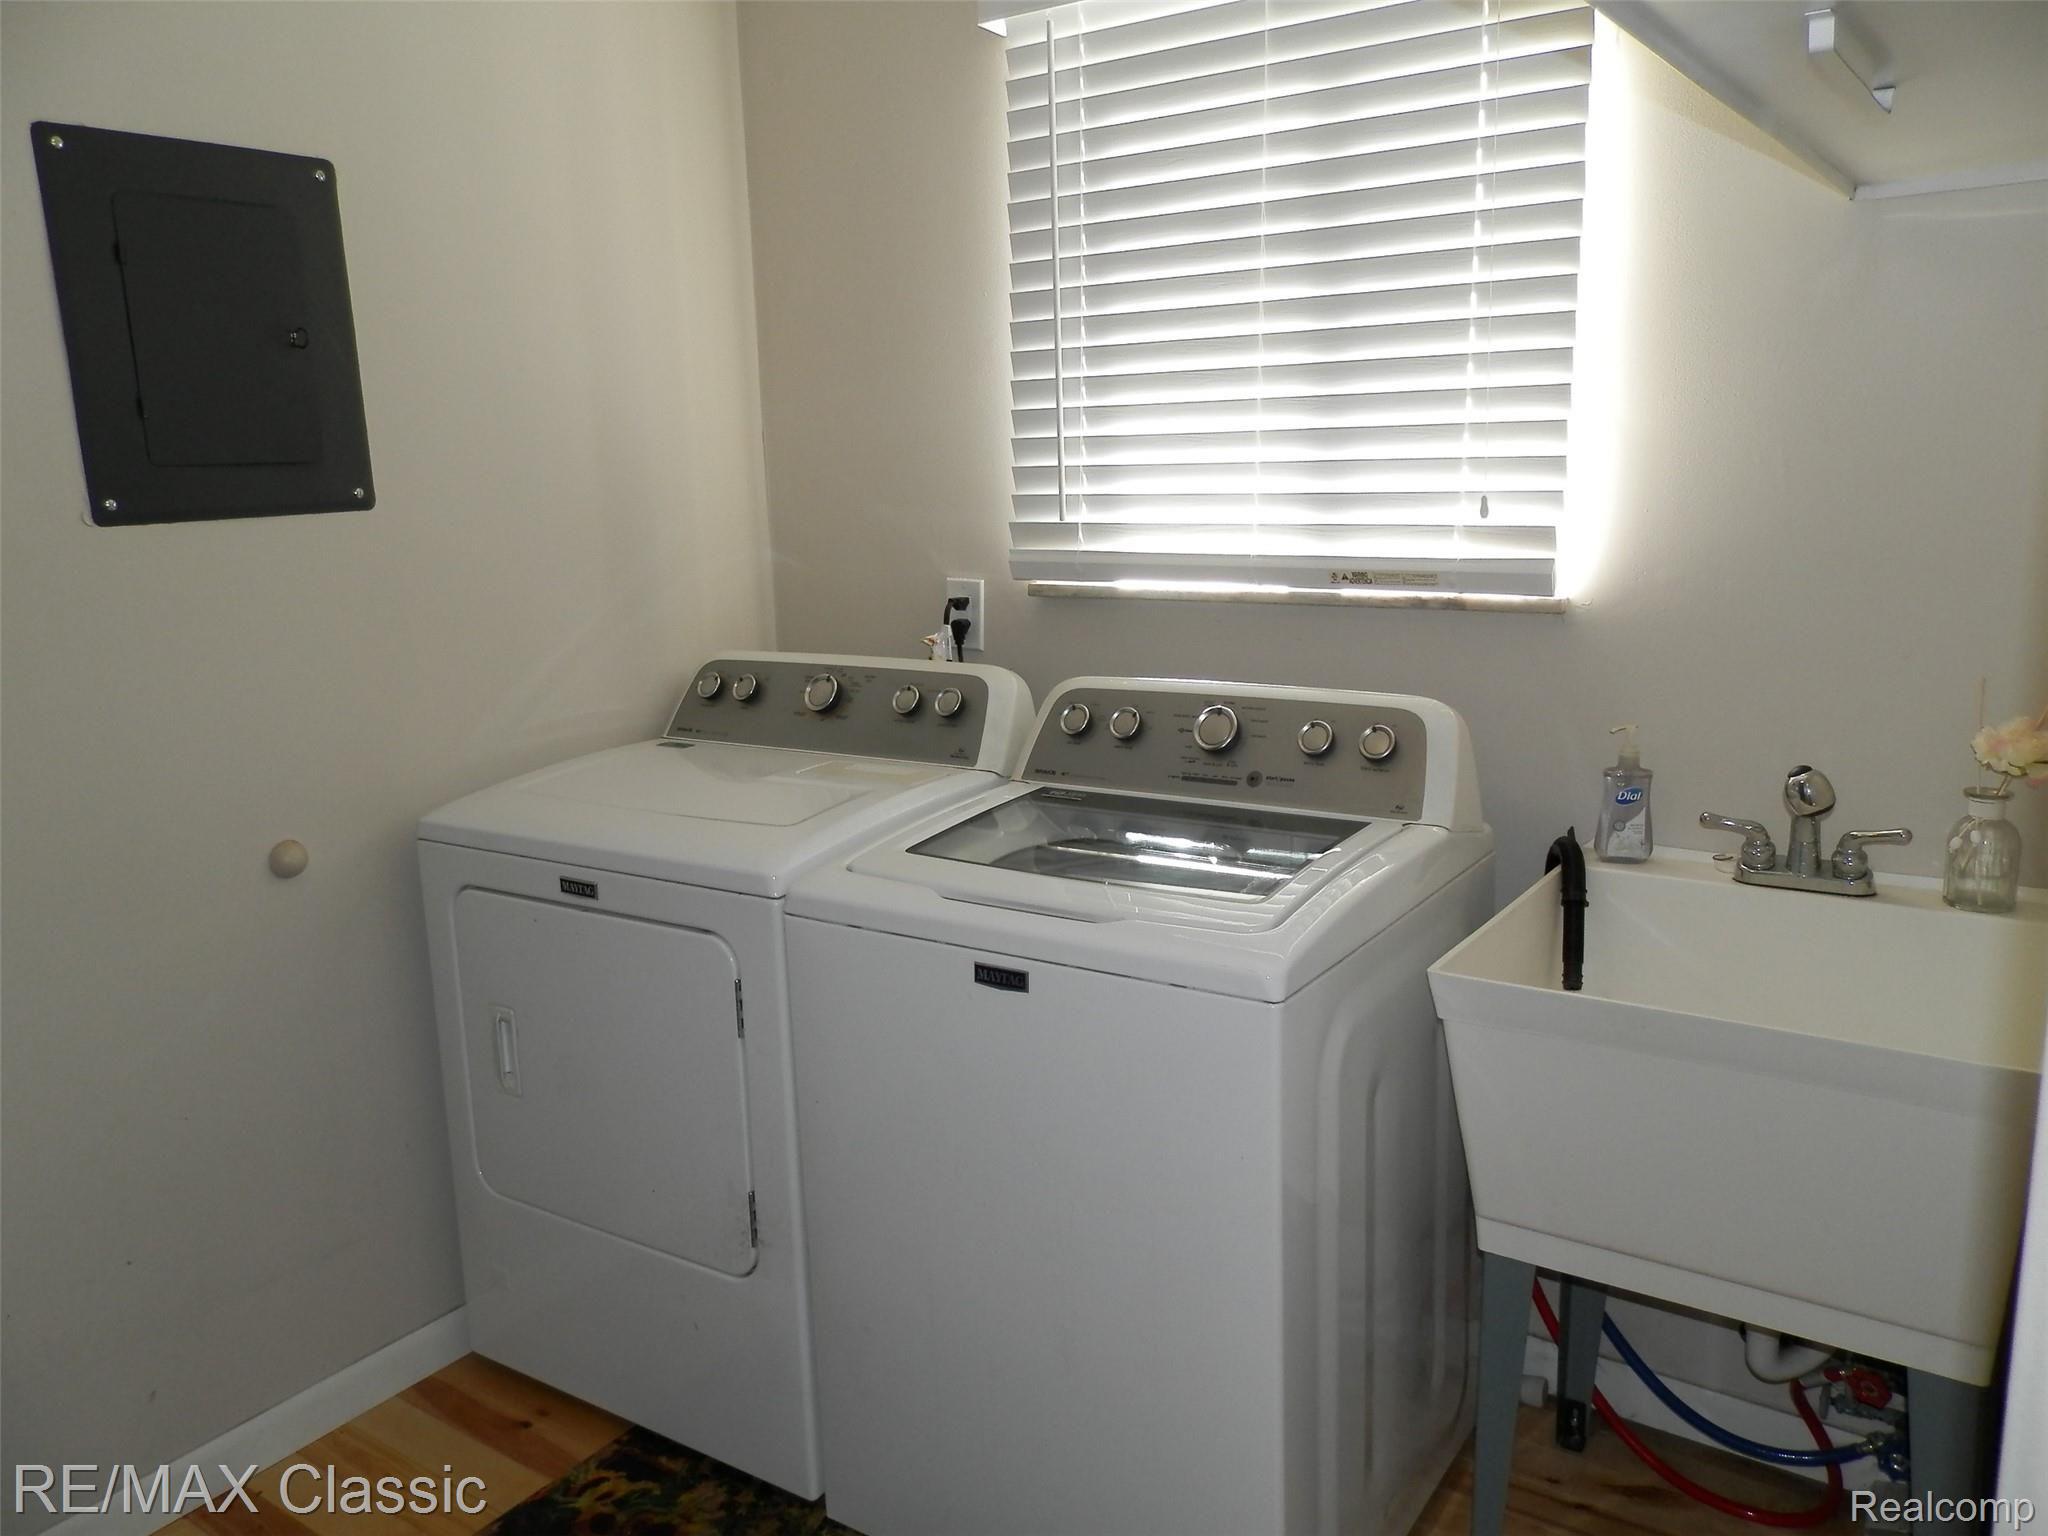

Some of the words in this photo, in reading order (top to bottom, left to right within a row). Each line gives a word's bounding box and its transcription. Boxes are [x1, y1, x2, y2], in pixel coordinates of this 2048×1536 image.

[1617, 791, 1642, 801] Dial
[561, 880, 594, 897] MAYTAG
[975, 967, 1025, 987] MAYTAG
